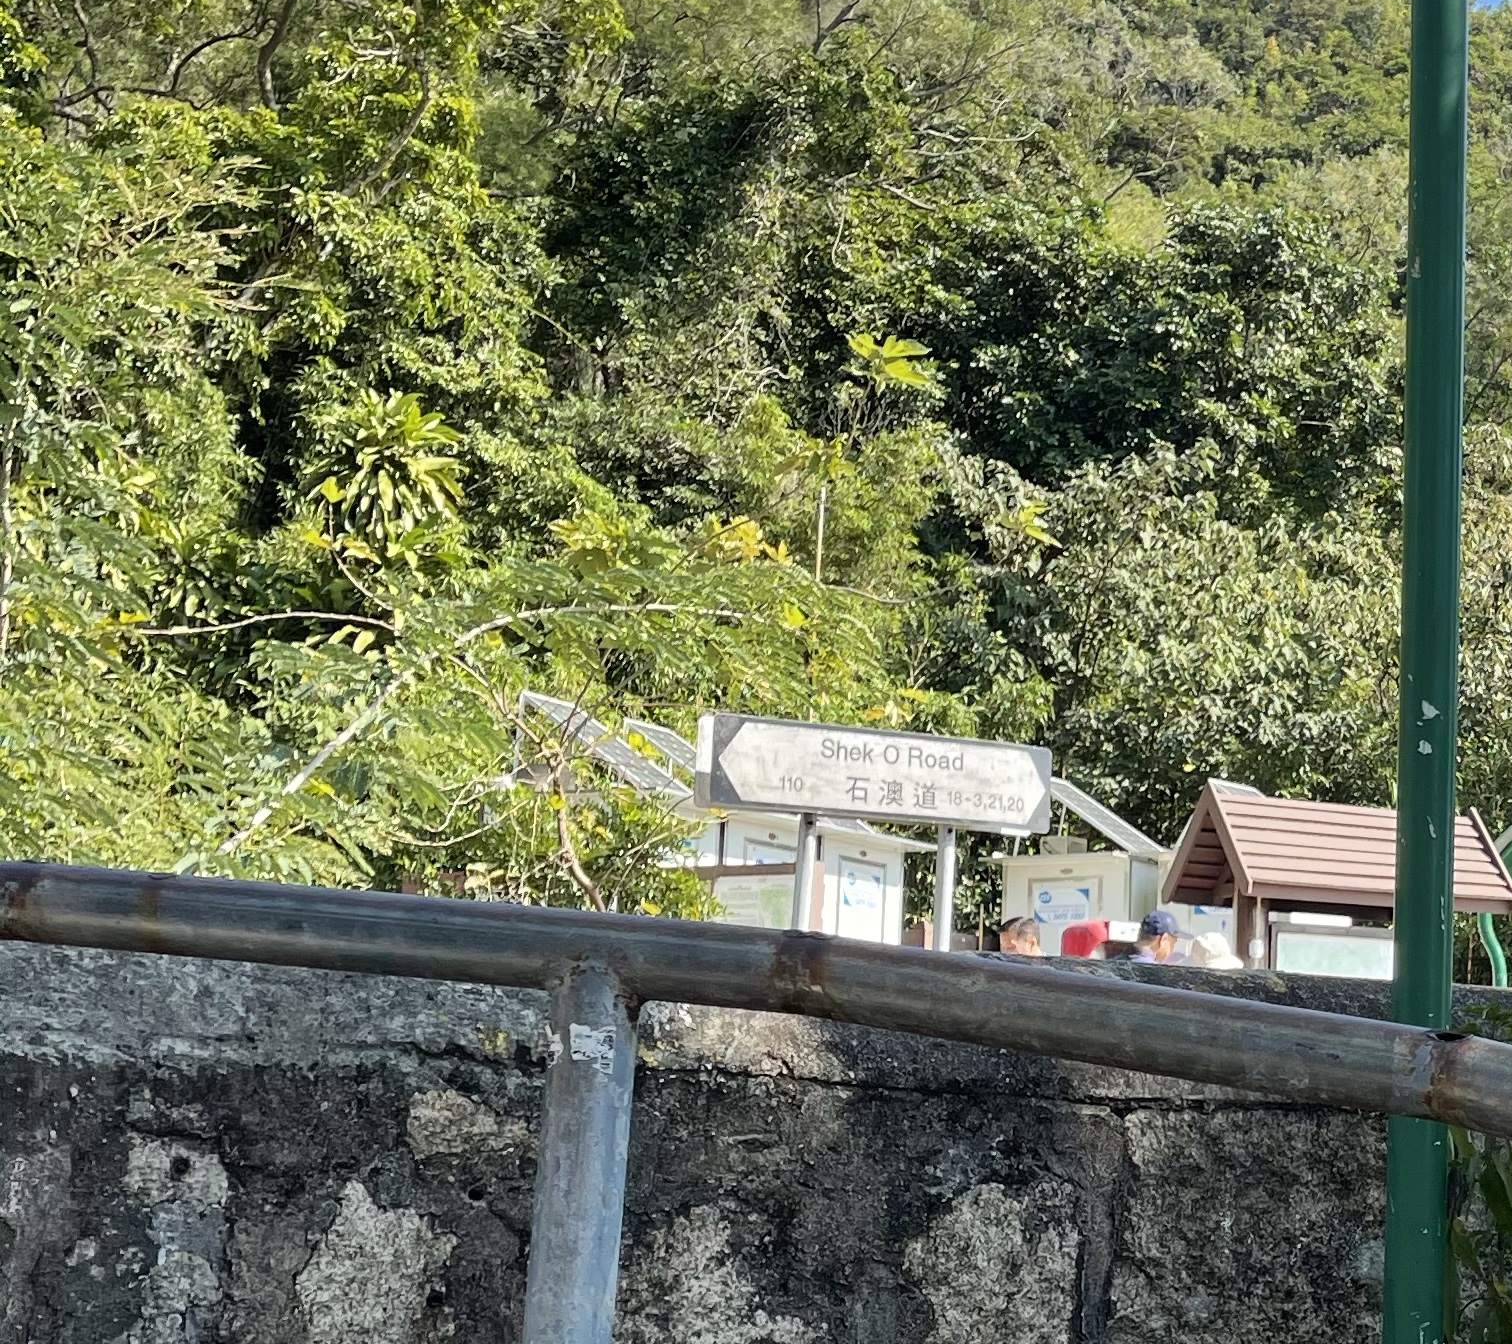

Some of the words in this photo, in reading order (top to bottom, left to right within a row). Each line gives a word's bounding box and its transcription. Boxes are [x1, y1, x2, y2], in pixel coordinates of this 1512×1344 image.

[820, 738, 875, 765] Shek
[883, 744, 900, 763] O
[908, 746, 964, 772] Road
[846, 775, 939, 810] 石澳道
